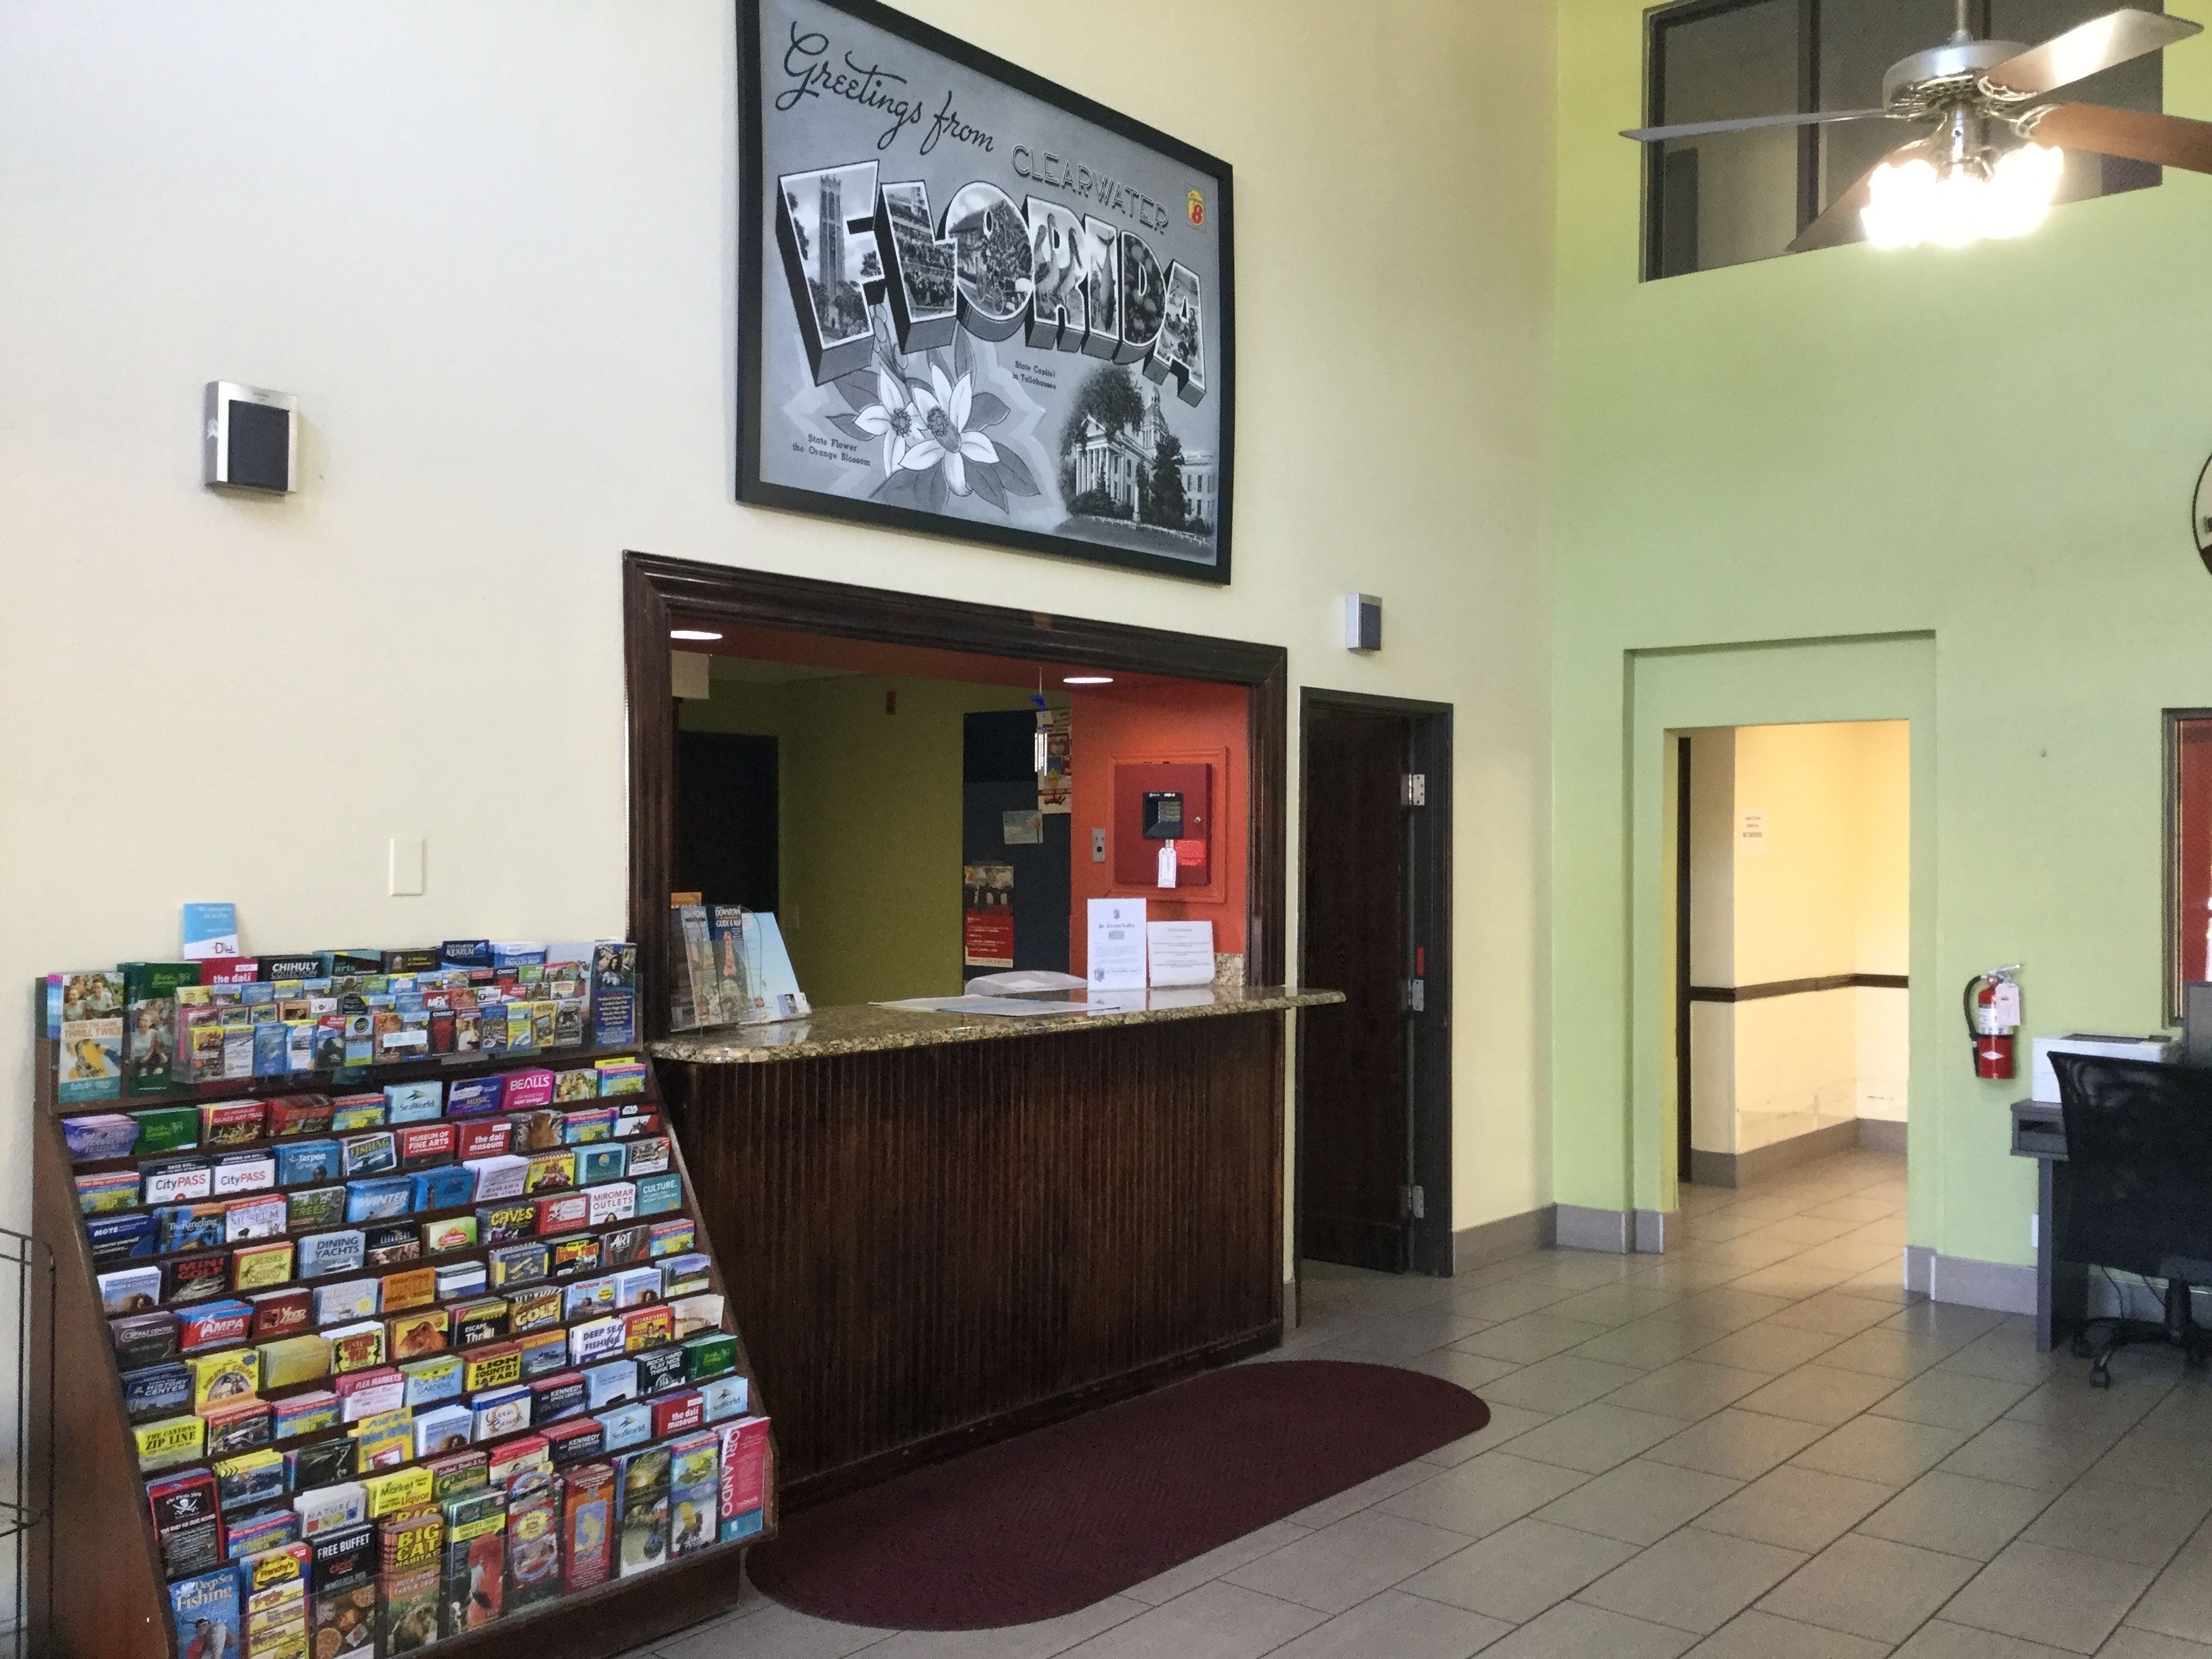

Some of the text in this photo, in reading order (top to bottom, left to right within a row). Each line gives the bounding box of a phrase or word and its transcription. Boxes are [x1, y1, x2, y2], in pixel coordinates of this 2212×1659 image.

[775, 20, 994, 155] Greetings from
[1012, 144, 1169, 234] CLEARWATER
[1191, 204, 1204, 226] 8
[777, 160, 1206, 406] FLORIDA
[1012, 372, 1019, 380] in
[1015, 361, 1055, 377] State Capitol
[808, 434, 857, 451] State Flower
[793, 443, 871, 466] the Orange Blossom
[272, 962, 319, 972] CHIHULY
[213, 975, 229, 983] the
[510, 1077, 550, 1091] BEALLS
[400, 1100, 436, 1111] SeaWorld
[409, 1132, 438, 1142] MUSEUM
[409, 1138, 449, 1149] FINE ARTS
[489, 1132, 504, 1141] dalí
[470, 1141, 503, 1151] museum
[156, 1174, 205, 1191] CityPASS
[221, 1171, 265, 1186] CityPASS
[593, 1189, 633, 1202] MIROMAR
[293, 1204, 326, 1216] TREES
[593, 1197, 632, 1210] OUTLETS
[182, 1217, 218, 1231] Ringling
[491, 1207, 535, 1227] CAVES
[317, 1237, 359, 1249] DINING
[610, 1232, 632, 1249] ART
[315, 1246, 359, 1258] YACHTS
[515, 1302, 558, 1326] GOLF
[201, 1318, 244, 1337] TAMPA
[583, 1324, 624, 1340] DEEP SEA
[466, 1328, 494, 1343] Thrll
[585, 1336, 619, 1351] FISHING
[476, 1355, 518, 1370] LION
[647, 1351, 682, 1367] ROCK HARD
[650, 1357, 680, 1371] PLAY NICE
[475, 1364, 517, 1378] COUNTRY
[650, 1361, 680, 1376] THINK BIG
[146, 1379, 187, 1390] HISTORY
[356, 1374, 402, 1389] FLEA MARKETS
[475, 1370, 517, 1385] SAFARI
[144, 1385, 185, 1396] CENTER
[550, 1384, 583, 1397] KENNEDY
[564, 1390, 583, 1398] CENTER
[713, 1396, 741, 1412] SeaWorld
[668, 1416, 698, 1429] museum
[612, 1422, 645, 1440] SeaWorld
[146, 1431, 196, 1450] ZIP LINE
[568, 1432, 600, 1446] KENNEDY
[721, 1430, 740, 1517] ORLANDO
[379, 1481, 414, 1496] Market
[401, 1492, 429, 1506] Liquor
[398, 1523, 439, 1549] BIG
[318, 1533, 370, 1559] FREE BUFFET
[396, 1538, 436, 1561] CAT
[396, 1551, 437, 1568] HABITAT
[195, 1573, 234, 1591] Deep Sea
[176, 1586, 233, 1612] Fishing
